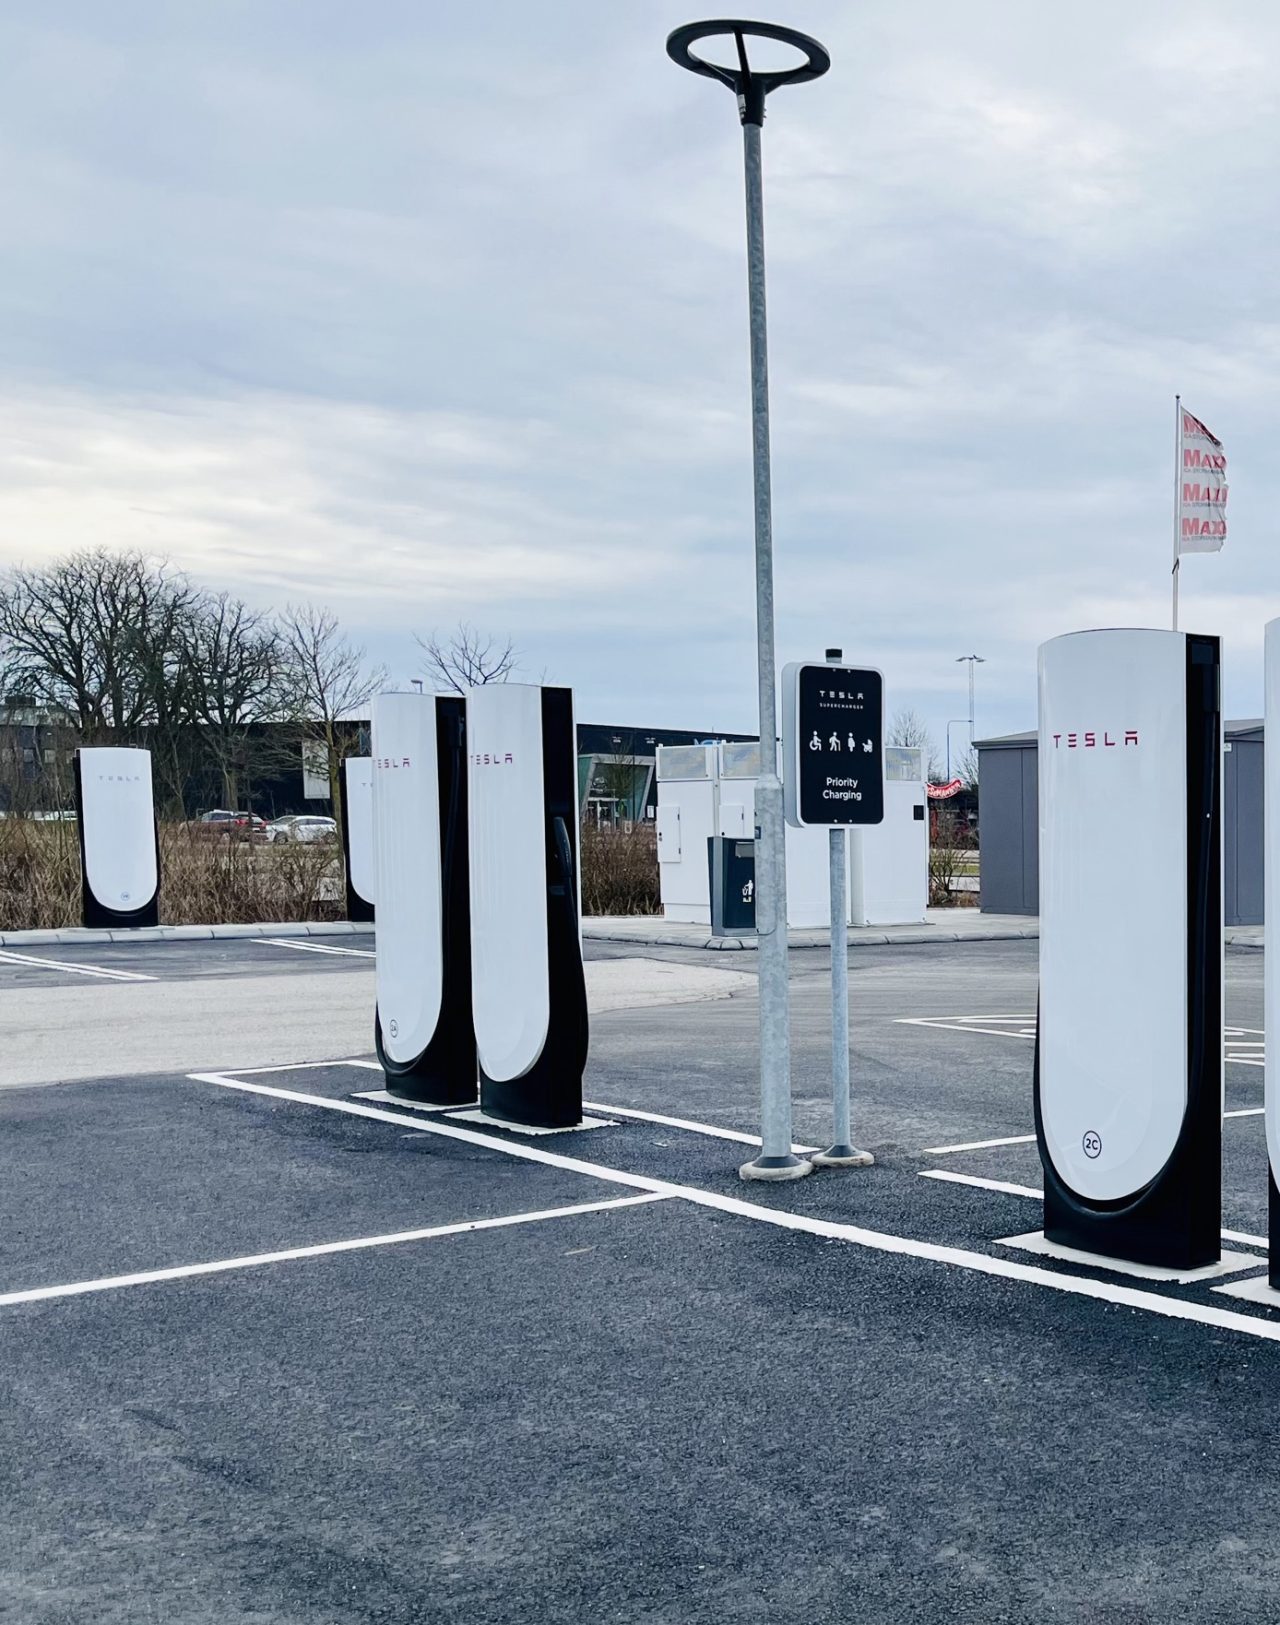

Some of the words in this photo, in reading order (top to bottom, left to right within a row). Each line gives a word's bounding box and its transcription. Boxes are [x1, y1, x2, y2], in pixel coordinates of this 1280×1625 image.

[820, 690, 863, 700] TESLA
[820, 702, 863, 710] SUPERCHARGER
[1053, 731, 1138, 749] TESLA
[826, 777, 858, 788] Priority
[823, 790, 862, 801] Charging
[1086, 1138, 1099, 1150] 2C
